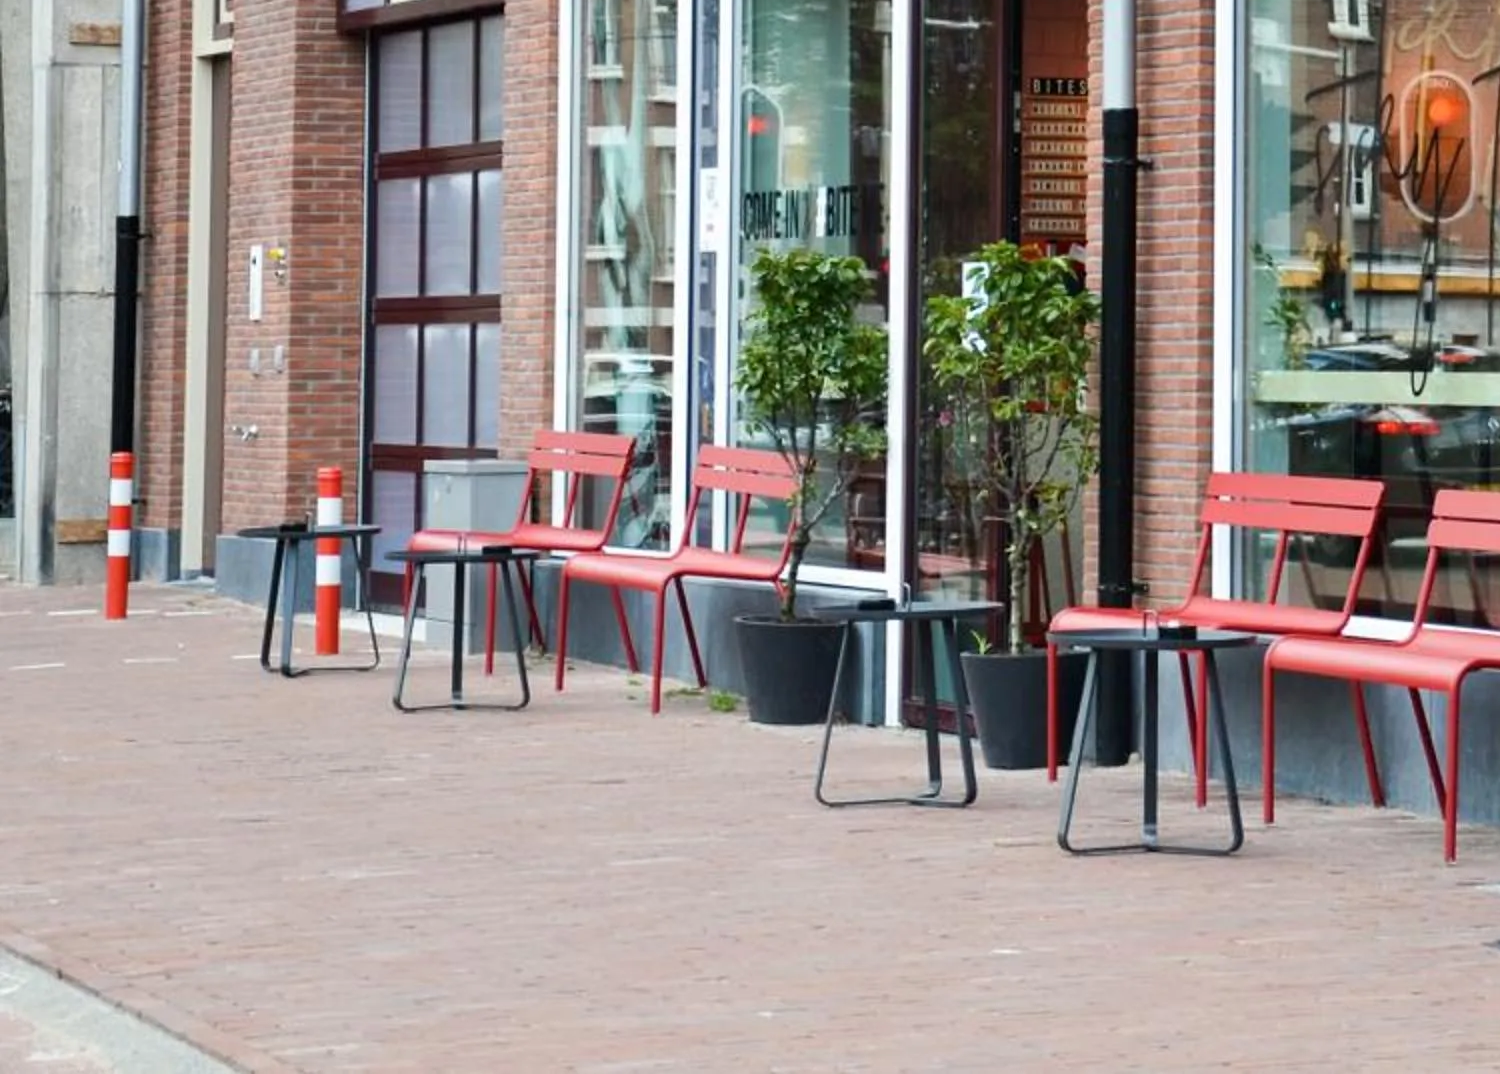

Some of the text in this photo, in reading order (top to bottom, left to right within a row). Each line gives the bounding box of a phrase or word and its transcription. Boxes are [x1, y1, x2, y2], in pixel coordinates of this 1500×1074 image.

[1033, 79, 1087, 95] BITES
[743, 190, 782, 240] COME
[784, 189, 799, 239] IN
